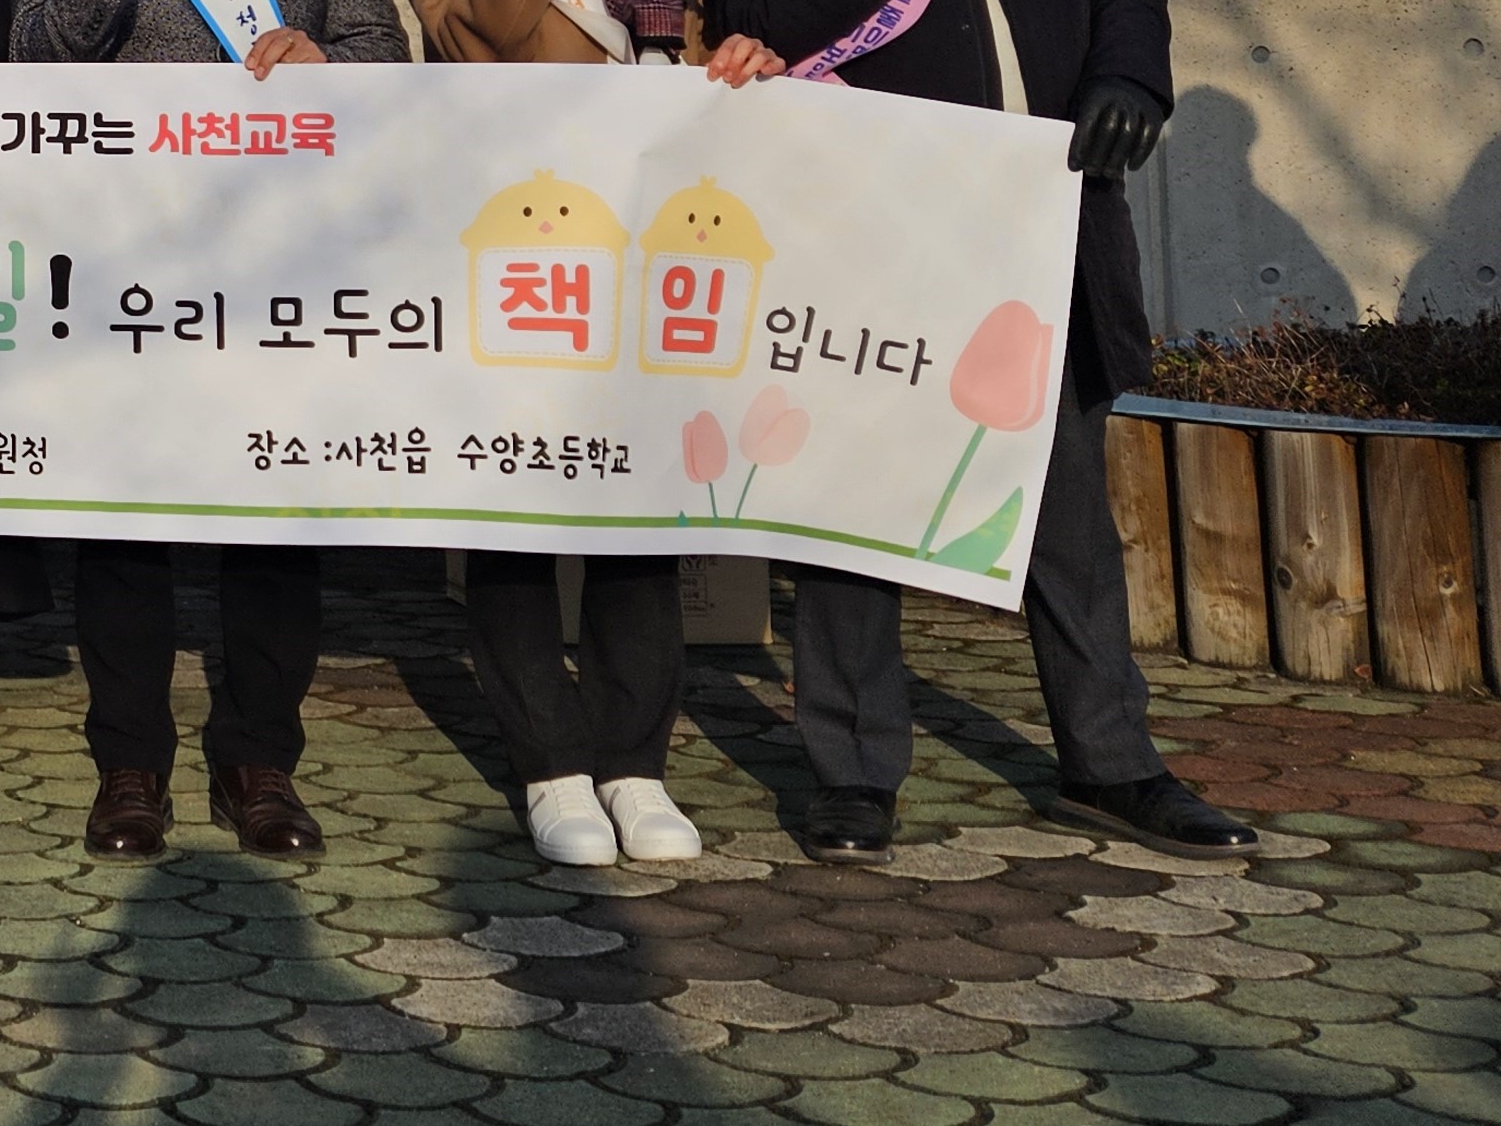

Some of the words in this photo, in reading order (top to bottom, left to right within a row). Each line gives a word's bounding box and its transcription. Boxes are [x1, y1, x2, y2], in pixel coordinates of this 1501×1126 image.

[0, 111, 136, 155] 가꾸는
[148, 112, 336, 157] 사천교육
[109, 282, 225, 355] 우리
[258, 288, 443, 359] 모두의
[456, 432, 632, 481] 수양초등학교
